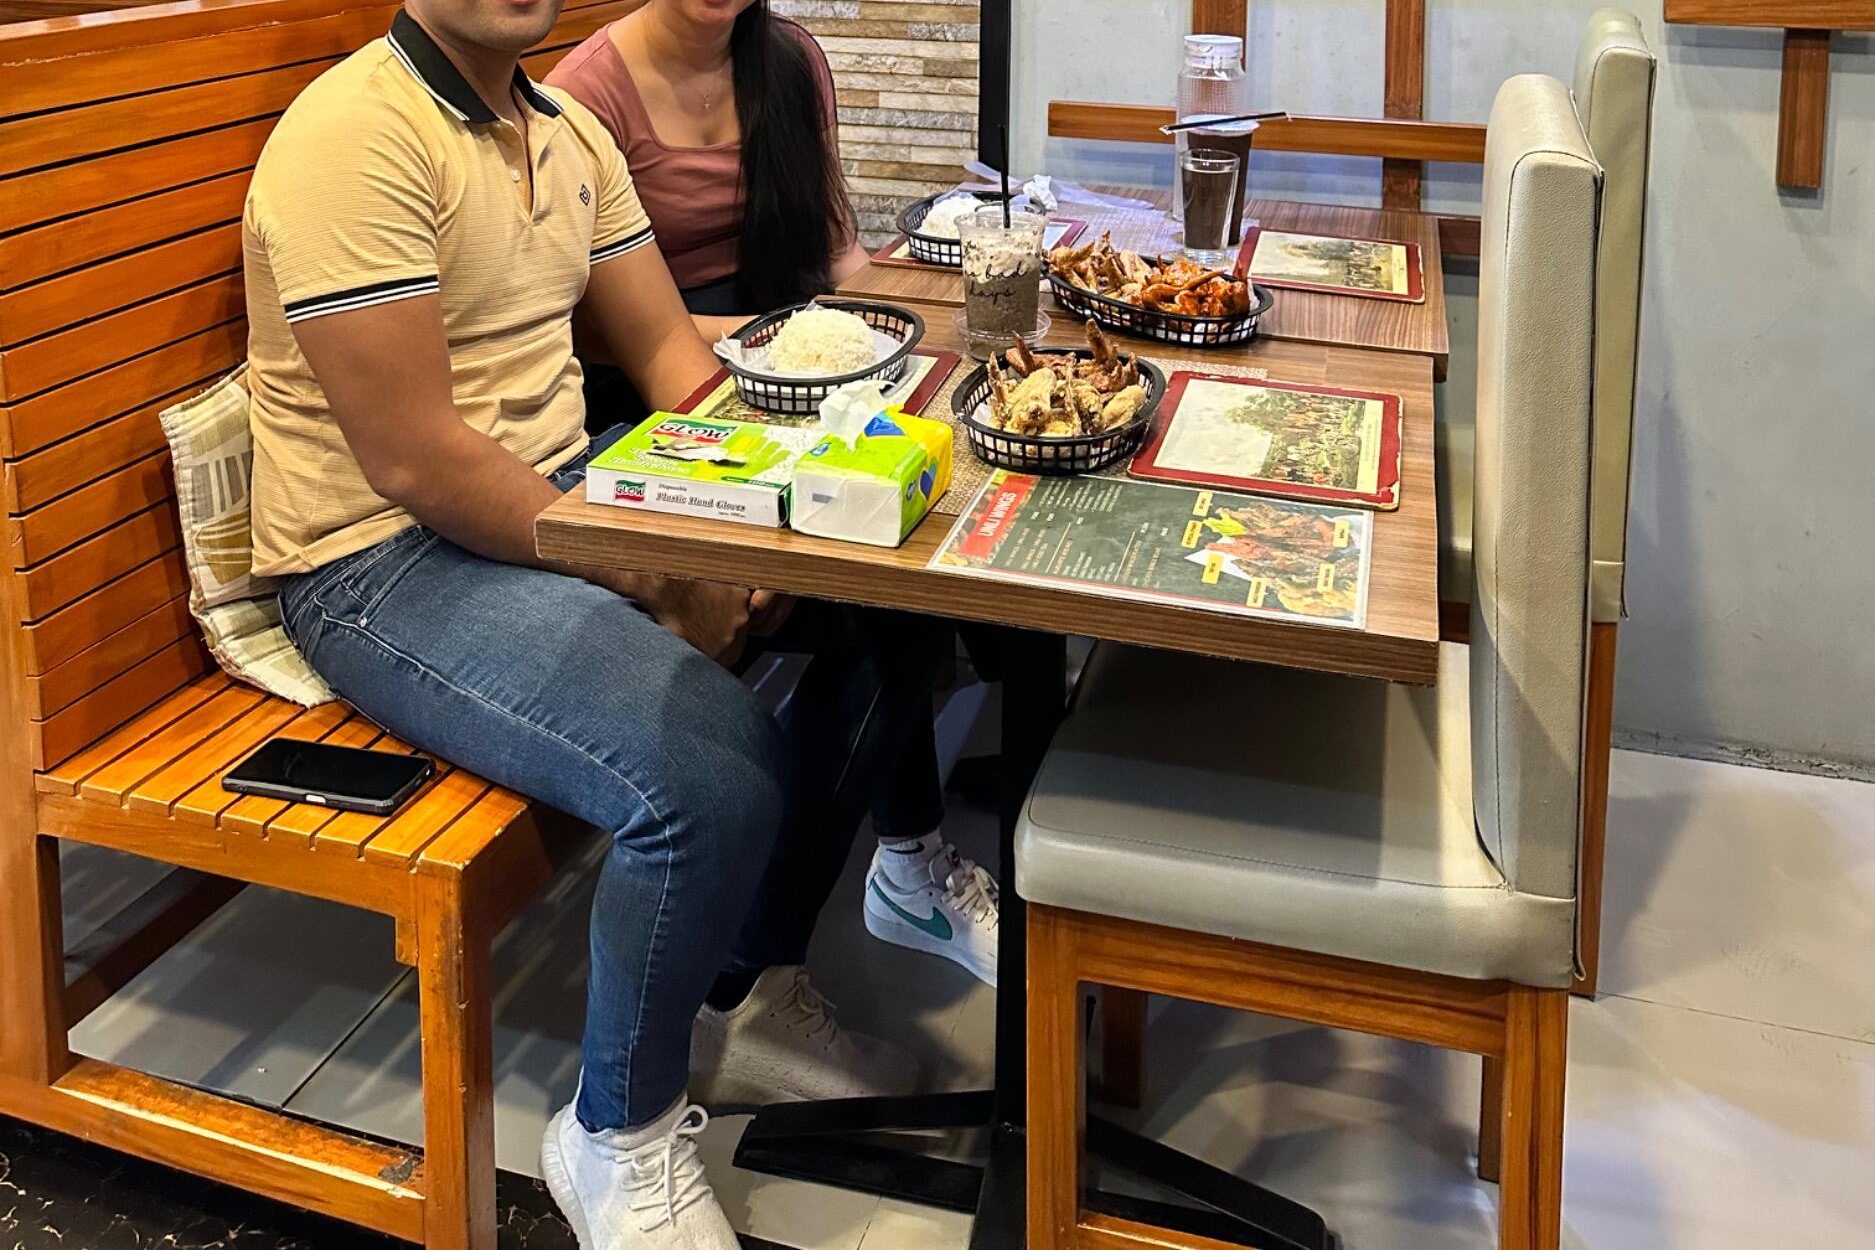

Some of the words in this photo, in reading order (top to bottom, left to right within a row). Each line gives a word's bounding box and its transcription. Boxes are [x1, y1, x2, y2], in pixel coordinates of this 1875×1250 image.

[969, 281, 1016, 305] days
[659, 423, 730, 439] GLOW
[615, 485, 646, 497] GLOW
[656, 492, 687, 504] Plastic
[688, 496, 714, 508] Hand
[716, 500, 746, 512] Gloves
[988, 492, 1017, 518] WINGS
[978, 517, 1001, 536] UNLI
